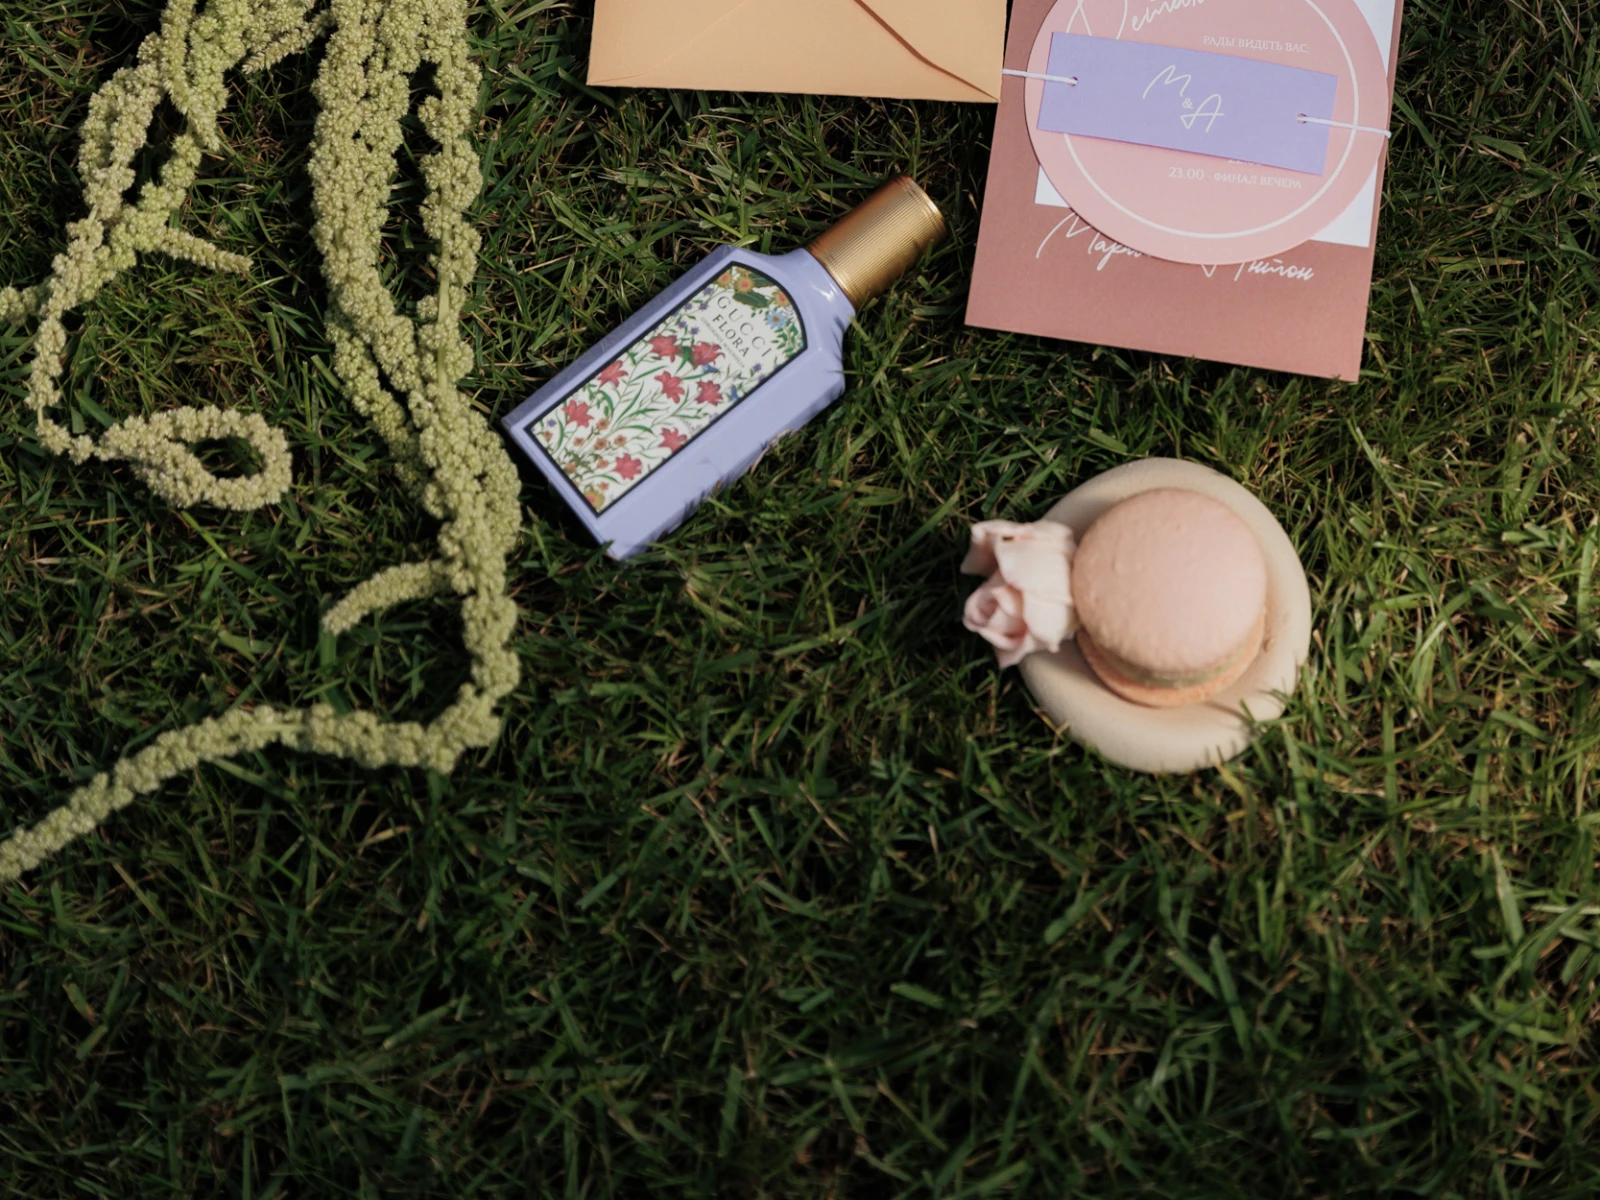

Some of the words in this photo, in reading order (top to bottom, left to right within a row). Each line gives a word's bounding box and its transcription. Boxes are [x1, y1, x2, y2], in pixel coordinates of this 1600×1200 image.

[1203, 35, 1235, 48] РАДЫ
[1238, 38, 1283, 51] ВИДЕТЬ
[1168, 166, 1205, 180] 23.00
[1213, 172, 1257, 185] ФИНАЛ
[1260, 175, 1302, 189] ВЕЧЕРА
[712, 314, 750, 357] FLORA
[717, 296, 772, 357] GUCCI
